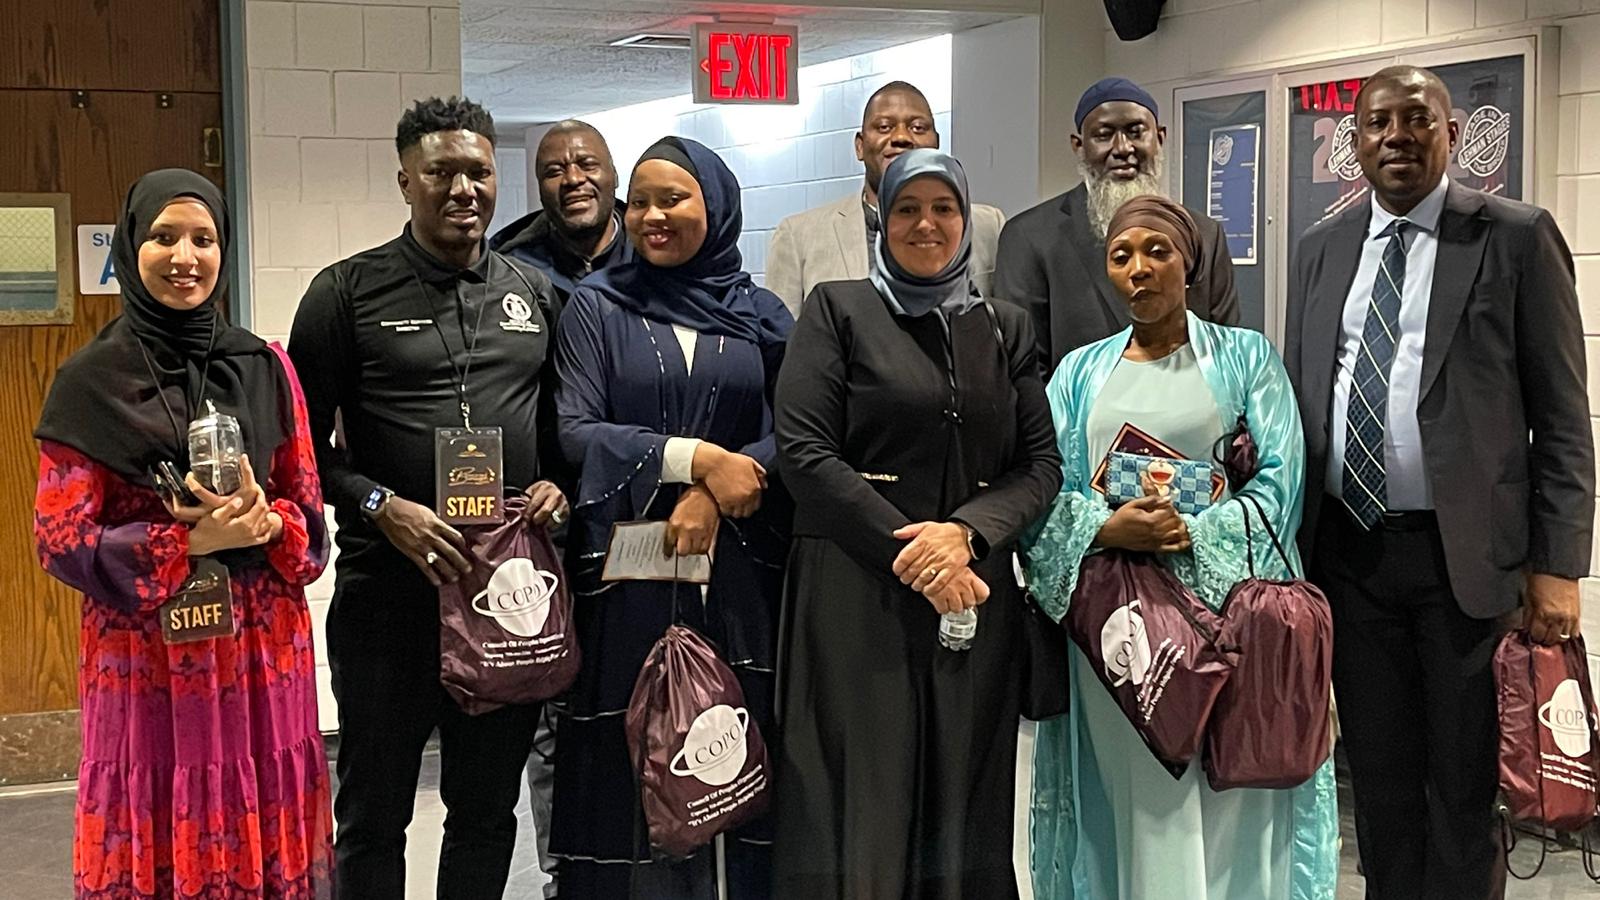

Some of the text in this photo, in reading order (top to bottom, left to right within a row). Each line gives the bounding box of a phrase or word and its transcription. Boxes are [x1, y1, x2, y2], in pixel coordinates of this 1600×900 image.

[709, 33, 792, 100] EXIT
[1465, 110, 1486, 140] MADE
[1487, 109, 1498, 120] IN
[1461, 136, 1487, 164] LEHMAN
[1473, 161, 1487, 173] THE
[92, 233, 111, 247] St
[446, 496, 496, 517] STAFF
[170, 603, 222, 630] STAFF
[694, 723, 740, 764] COPO
